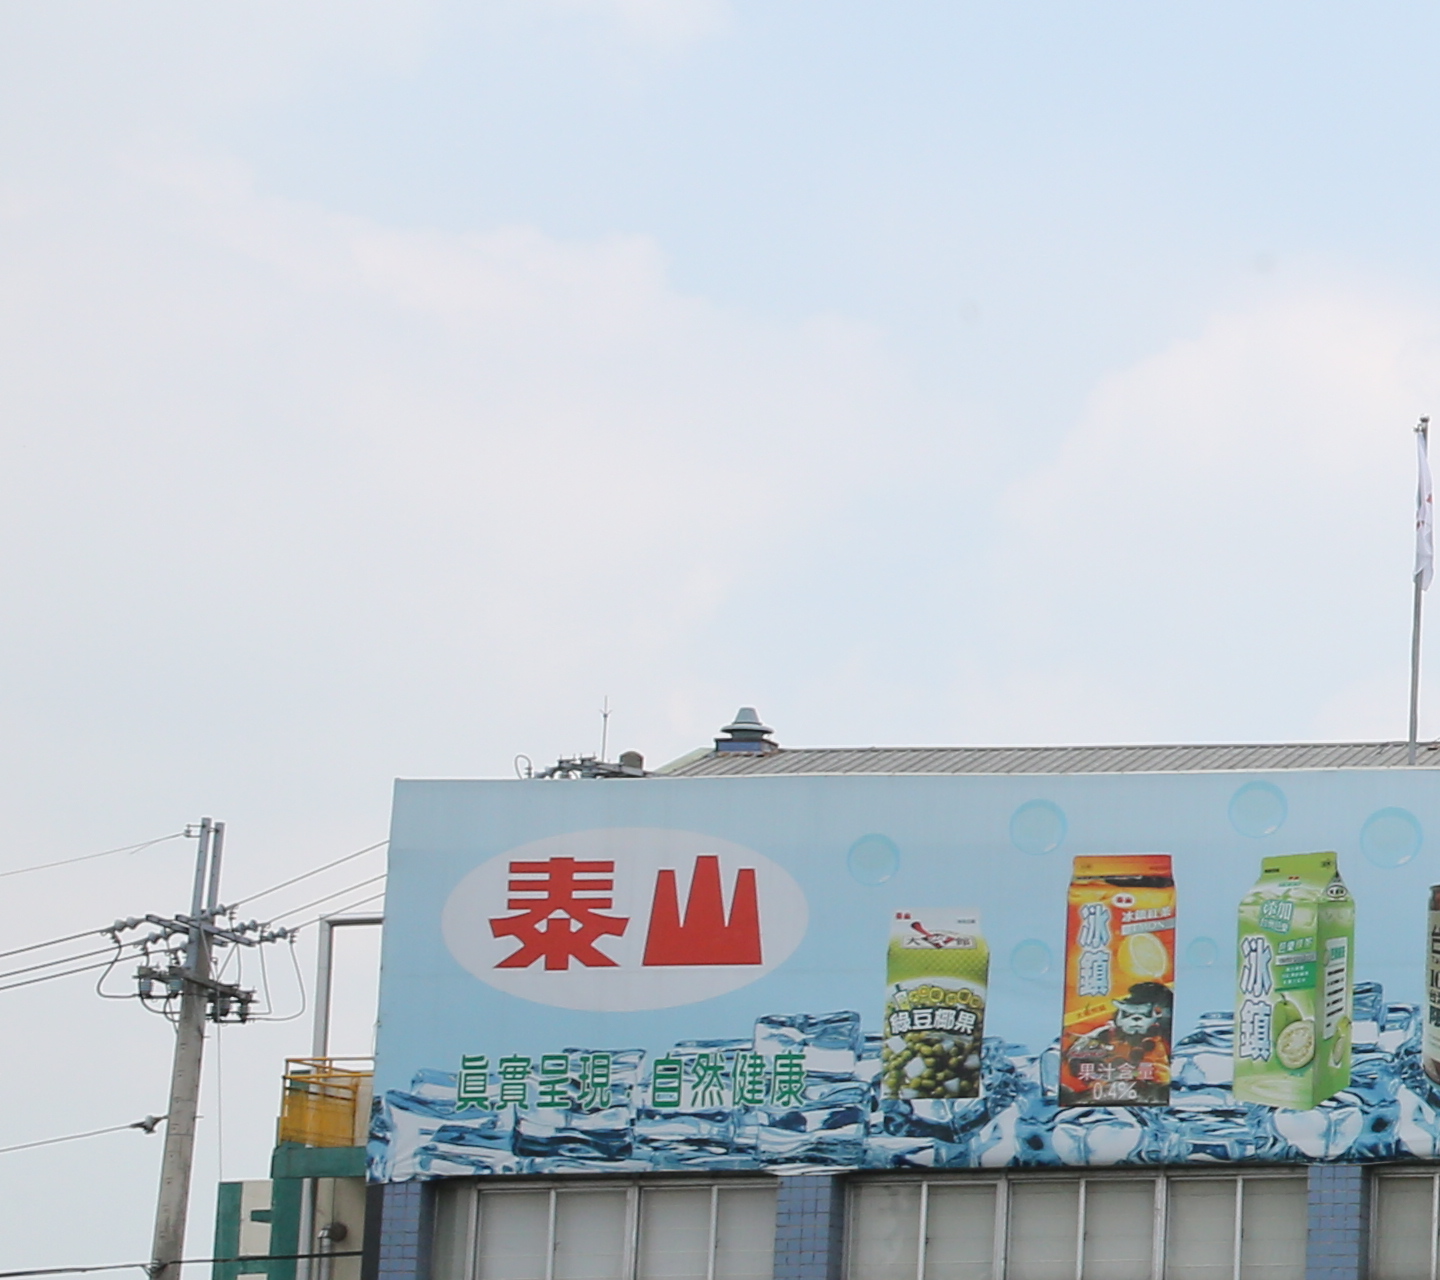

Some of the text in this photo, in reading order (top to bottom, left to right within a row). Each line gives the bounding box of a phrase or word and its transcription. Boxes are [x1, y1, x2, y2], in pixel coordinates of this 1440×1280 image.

[488, 855, 763, 971] 泰山
[1079, 1063, 1154, 1080] 果汁含量
[1093, 1081, 1138, 1100] 0.4%
